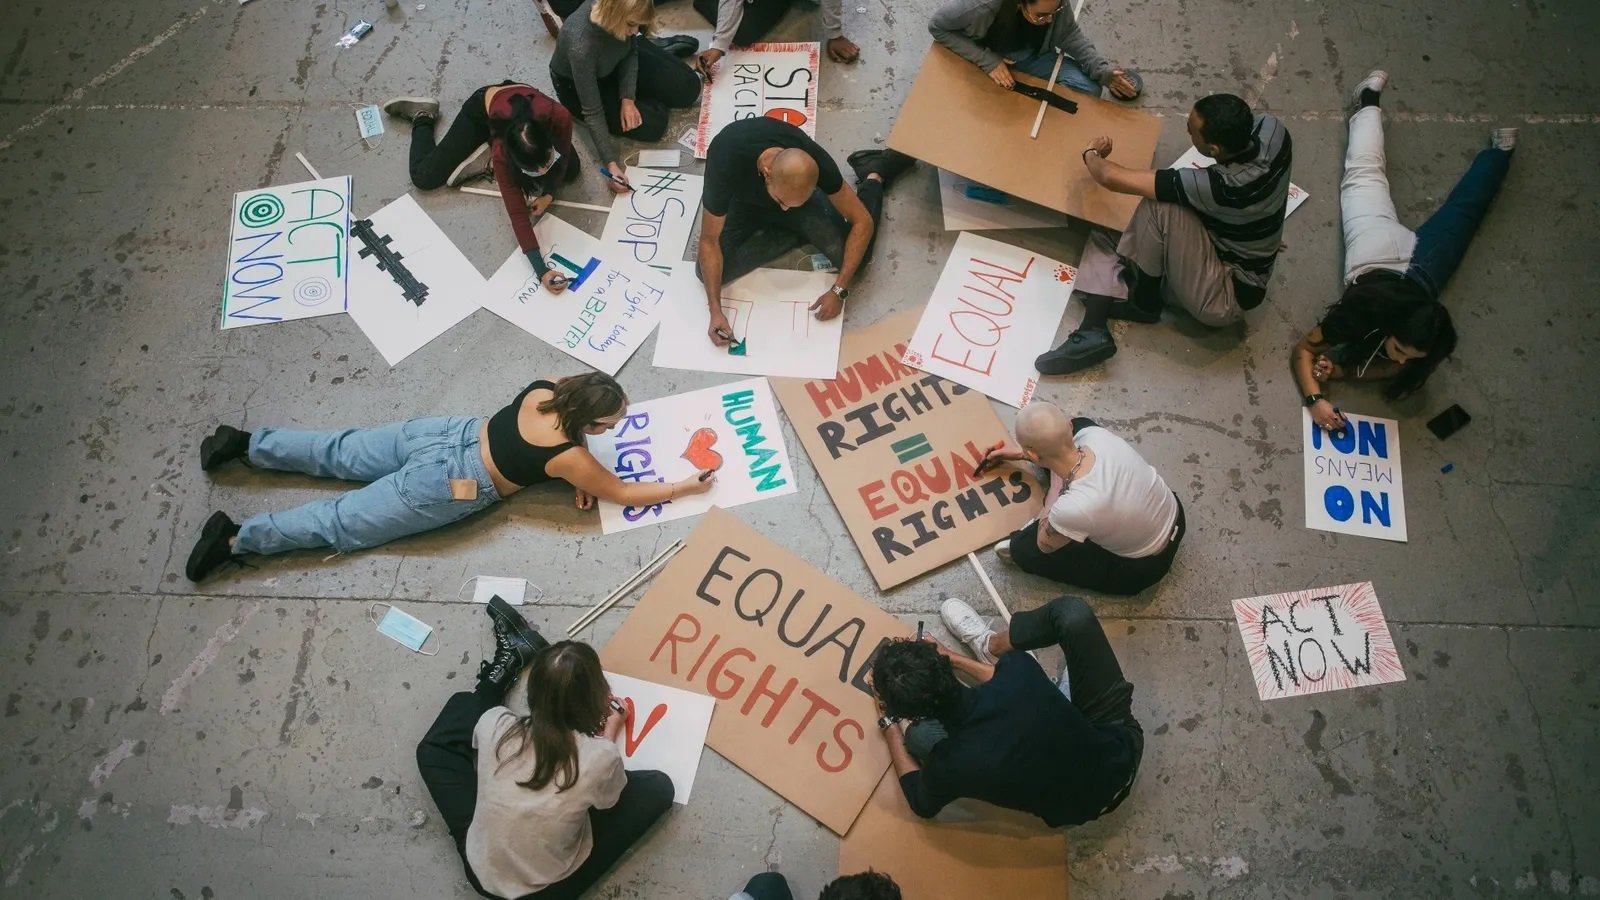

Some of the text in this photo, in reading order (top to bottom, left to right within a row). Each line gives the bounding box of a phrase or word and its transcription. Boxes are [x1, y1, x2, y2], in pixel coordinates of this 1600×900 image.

[733, 63, 761, 121] RACIS
[287, 188, 345, 278] ACT
[228, 231, 284, 321] NOW
[556, 269, 631, 349] for a BETTER
[588, 281, 665, 352] Fight today
[931, 256, 1035, 376] EQUAL
[614, 411, 673, 523] RIGHS
[722, 389, 787, 493] HUMAN
[1314, 455, 1393, 484] MEANS
[871, 470, 1032, 564] RIGHTS
[1323, 485, 1392, 528] NO
[1260, 594, 1344, 640] ACT
[649, 612, 865, 773] RIGHTS
[1266, 631, 1371, 690] NOW
